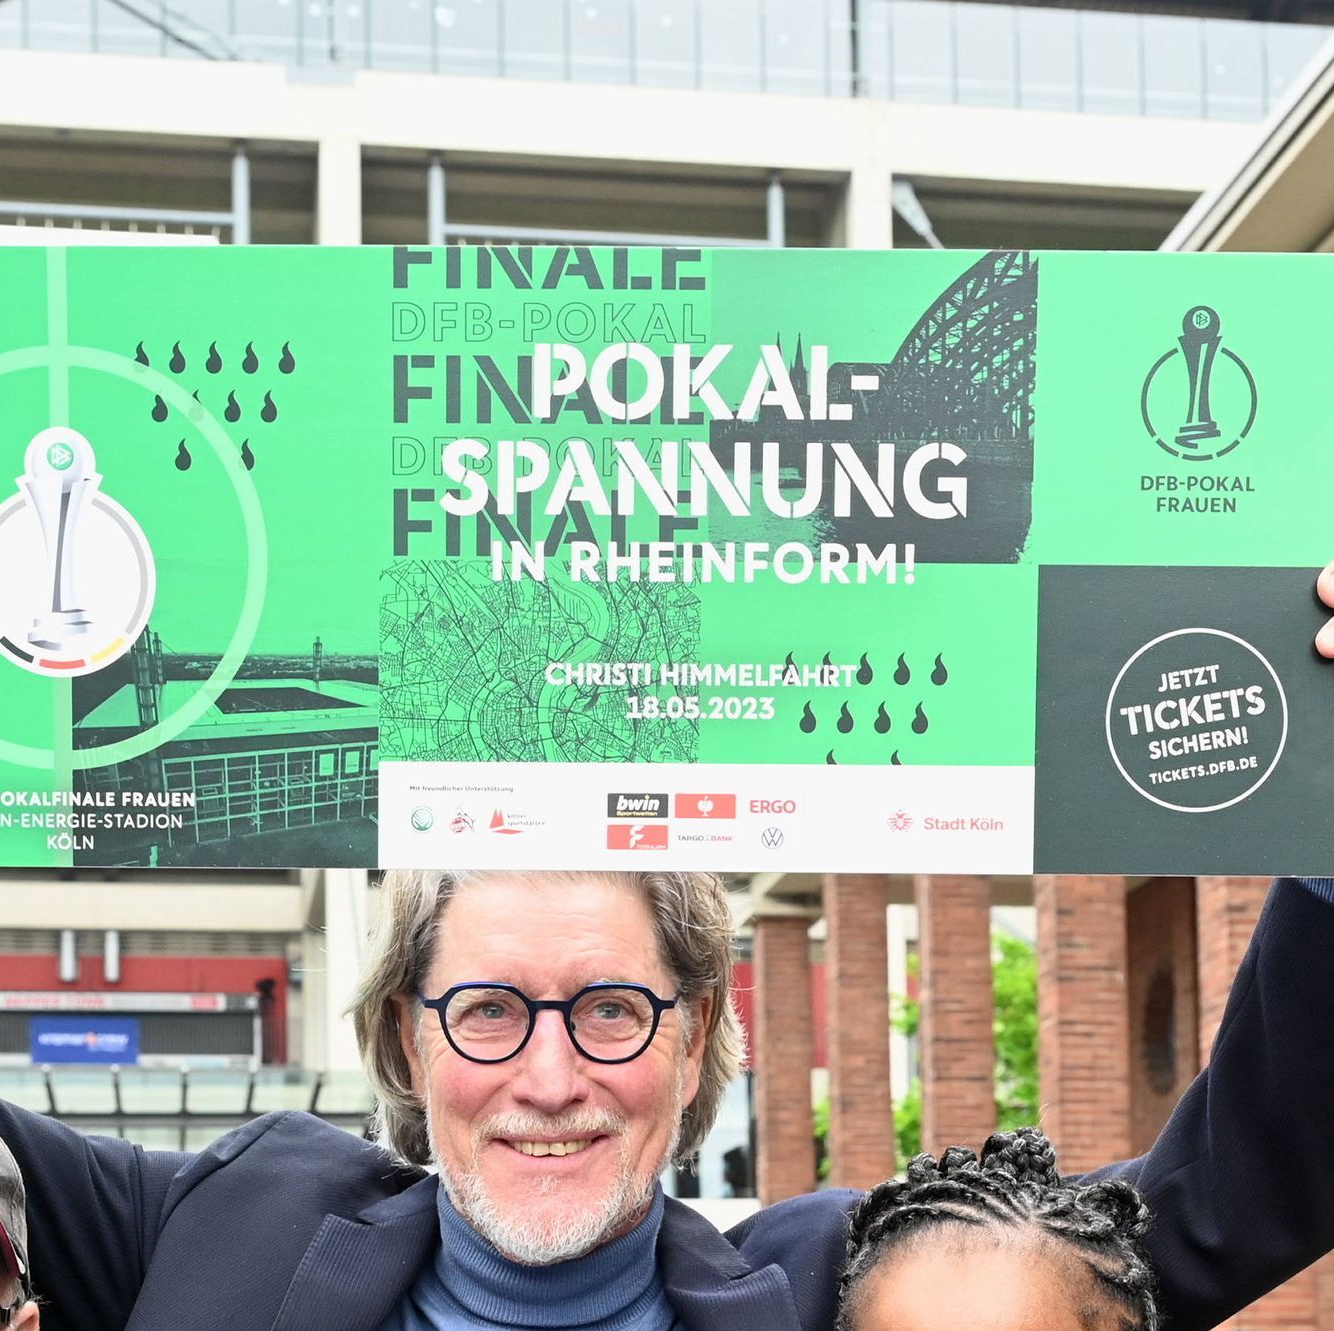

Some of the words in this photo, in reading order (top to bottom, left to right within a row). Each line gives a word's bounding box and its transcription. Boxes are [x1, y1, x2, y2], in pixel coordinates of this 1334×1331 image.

[392, 302, 706, 343] DFB-POKAL
[534, 342, 880, 420] POKAL-
[440, 437, 968, 520] SPANNUNG
[1140, 475, 1255, 492] DFB-POKAL
[1156, 497, 1237, 513] FRAUEN
[491, 540, 546, 582] IN
[571, 540, 916, 584] RHEINFORM!
[545, 662, 653, 689] CHRISTI
[660, 662, 859, 689] HIMMELFAHRT
[1158, 664, 1219, 692] JETZT
[627, 697, 775, 721] 18.05.2023
[1120, 685, 1266, 735] TICKETS
[1148, 726, 1249, 760] SICHERN!
[1149, 756, 1258, 784] TICKETS.DFB.DE
[122, 791, 195, 807] FRAUEN
[616, 795, 660, 811] bwin
[749, 799, 796, 814] ERGO
[924, 817, 966, 831] Stadt
[970, 817, 1004, 831] Köln
[46, 833, 94, 850] KÖLN
